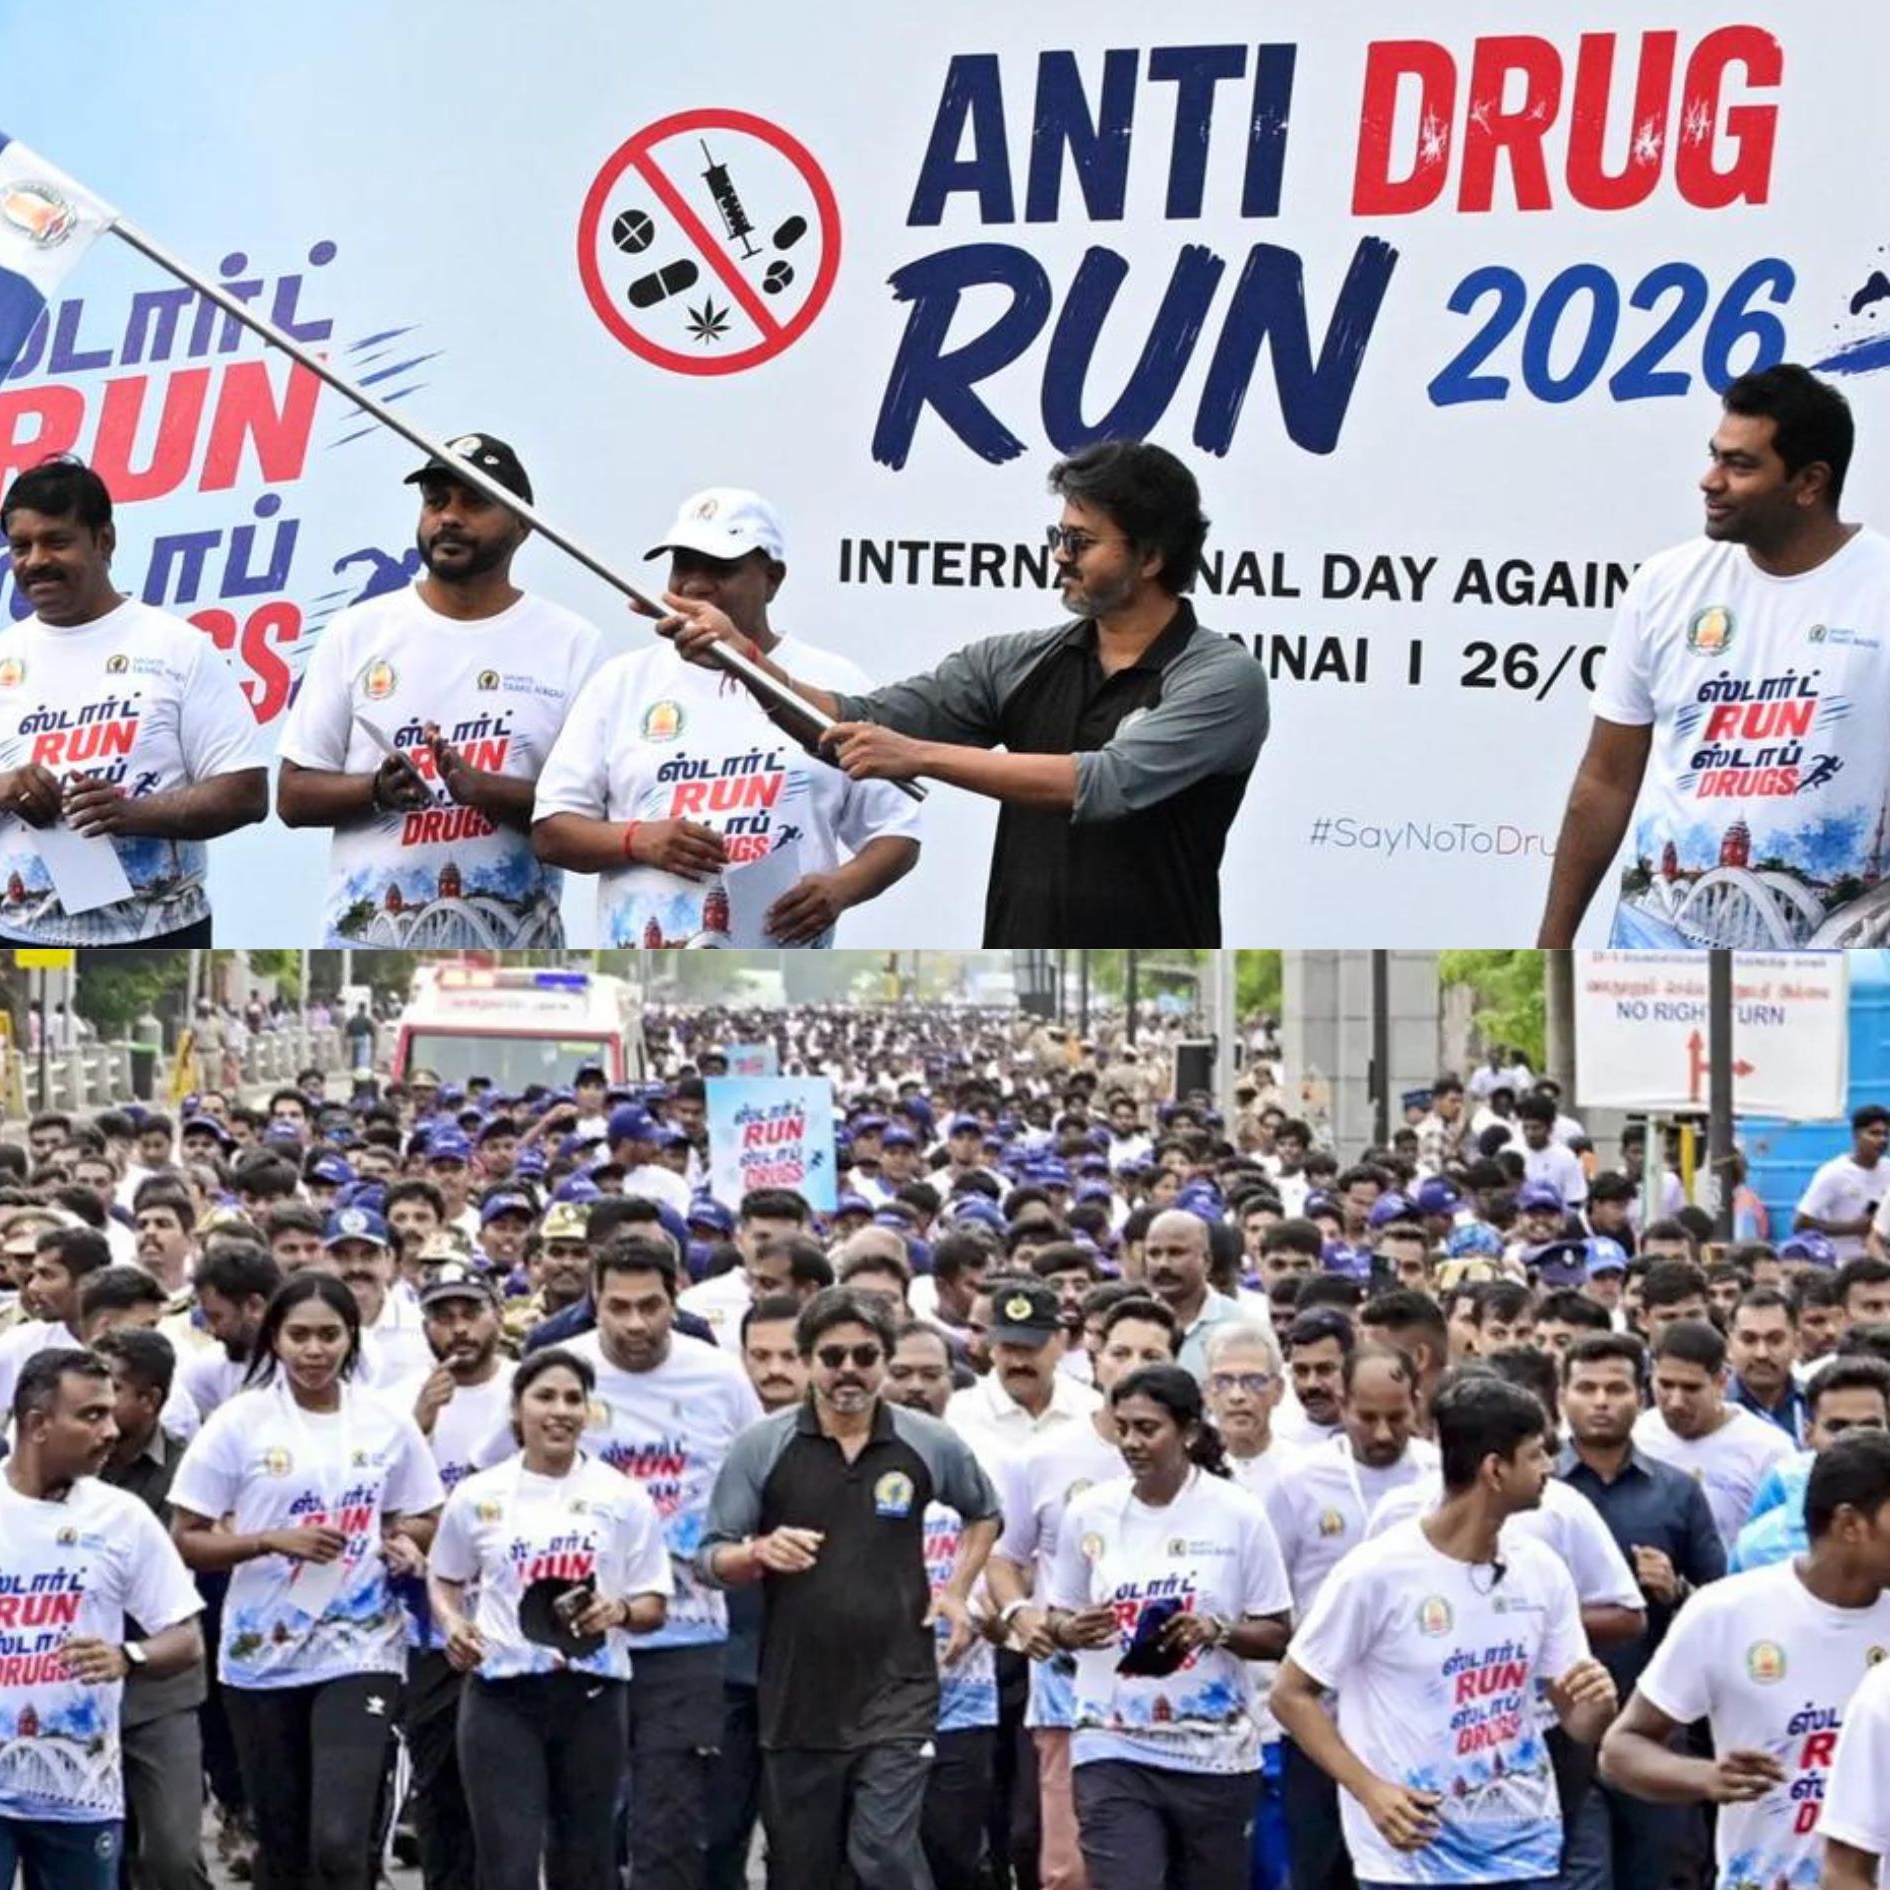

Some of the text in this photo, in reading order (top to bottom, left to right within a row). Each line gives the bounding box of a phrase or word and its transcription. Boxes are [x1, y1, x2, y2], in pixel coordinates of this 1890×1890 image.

[907, 24, 1784, 227] ANTI DRUG
[871, 235, 1796, 472] RUN 2026
[840, 538, 1641, 609] INTERNNAL DAY AGAIN
[1697, 668, 1821, 703] ஸ்டார்ட்
[19, 692, 141, 735] ஸ்டார்ட்
[1703, 700, 1816, 742] RUN
[31, 720, 138, 766] RUN
[1690, 739, 1803, 770] ஸ்டாப்
[657, 746, 786, 783] ஸ்டார்ட்
[1696, 768, 1801, 798] DRUGS
[670, 773, 783, 817] RUN
[1310, 818, 1557, 859] #SayNoToDru
[1617, 1000, 1785, 1024] NO RIGH URN
[744, 1117, 805, 1148] RUN
[1455, 1661, 1529, 1704] RUN
